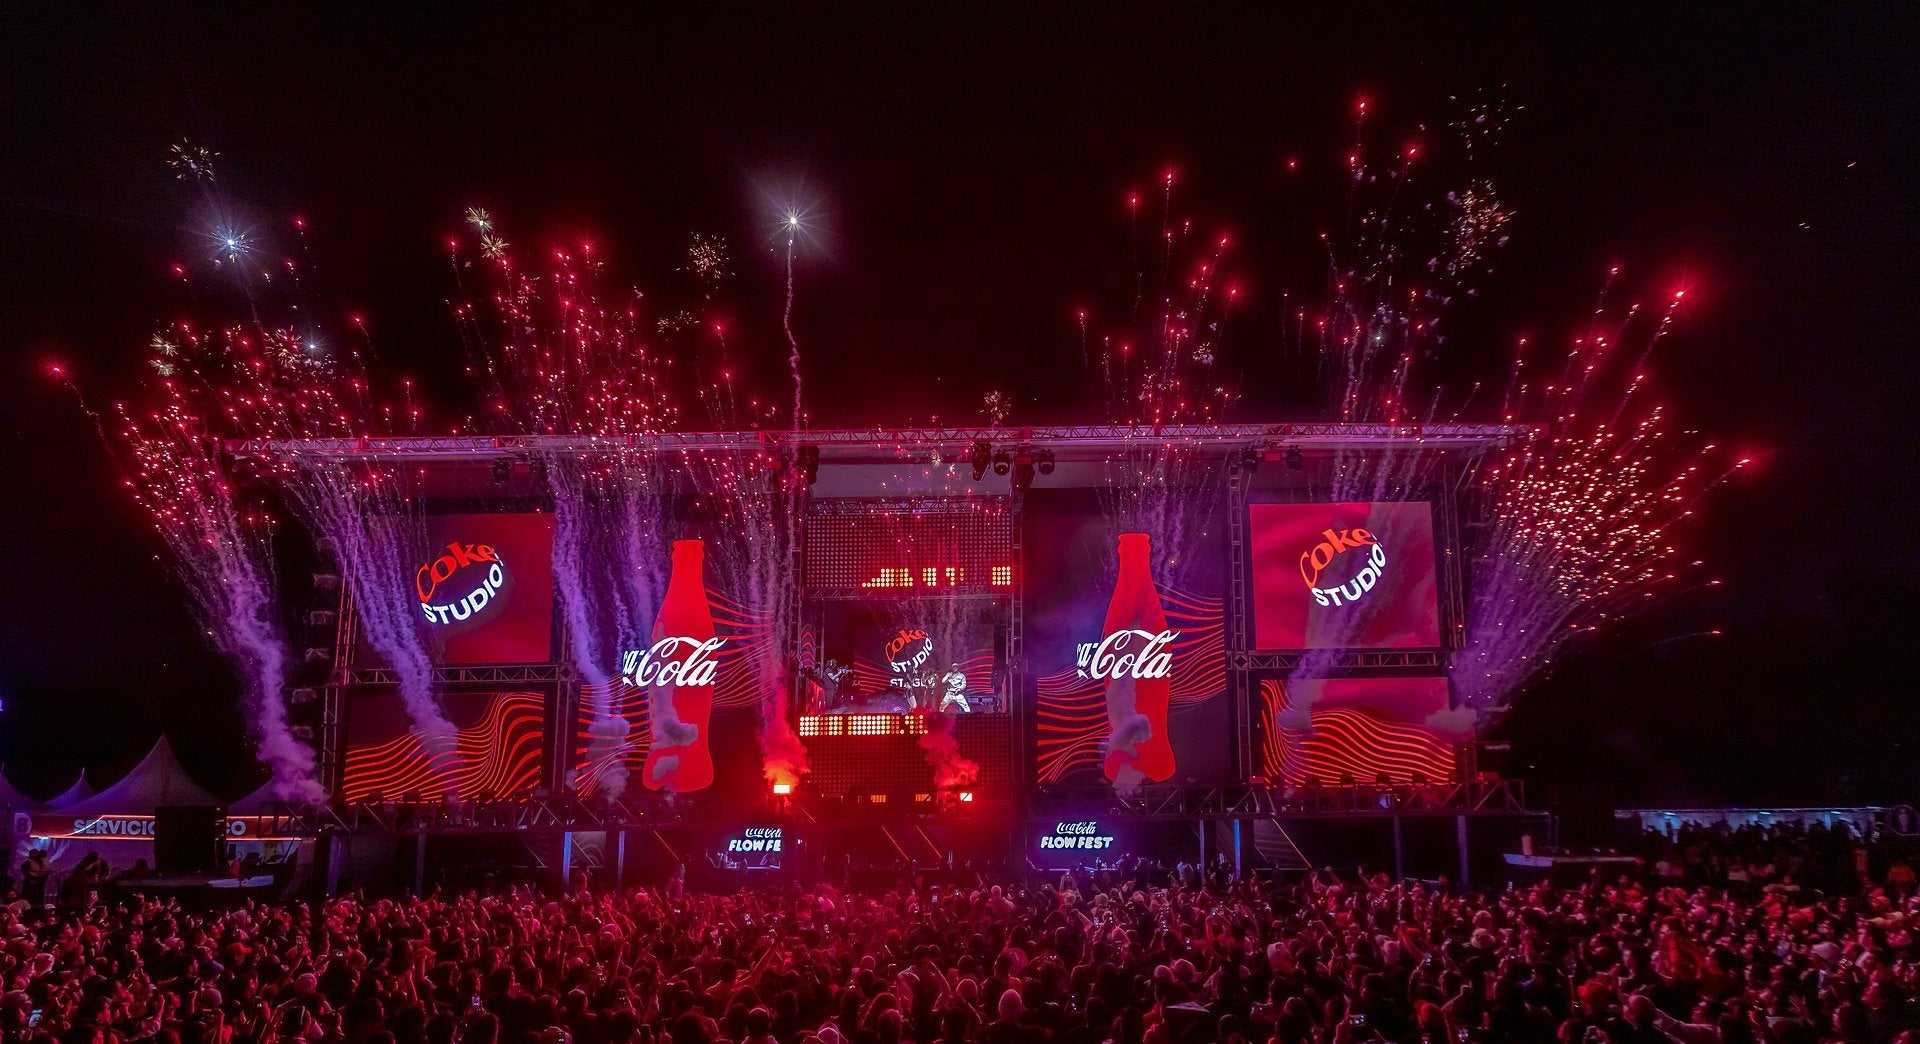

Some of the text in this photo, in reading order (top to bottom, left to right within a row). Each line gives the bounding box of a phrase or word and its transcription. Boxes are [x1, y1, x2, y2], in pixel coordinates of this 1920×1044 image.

[416, 542, 500, 603] Coke
[1300, 528, 1377, 590] Coke
[1311, 543, 1386, 607] STUDIO
[421, 563, 503, 624] STUDIO
[885, 629, 927, 662] Coke
[890, 637, 933, 673] STUDIO
[889, 678, 926, 688] STGE
[728, 839, 766, 852] FLOW
[1040, 836, 1114, 849] FLOW FEST
